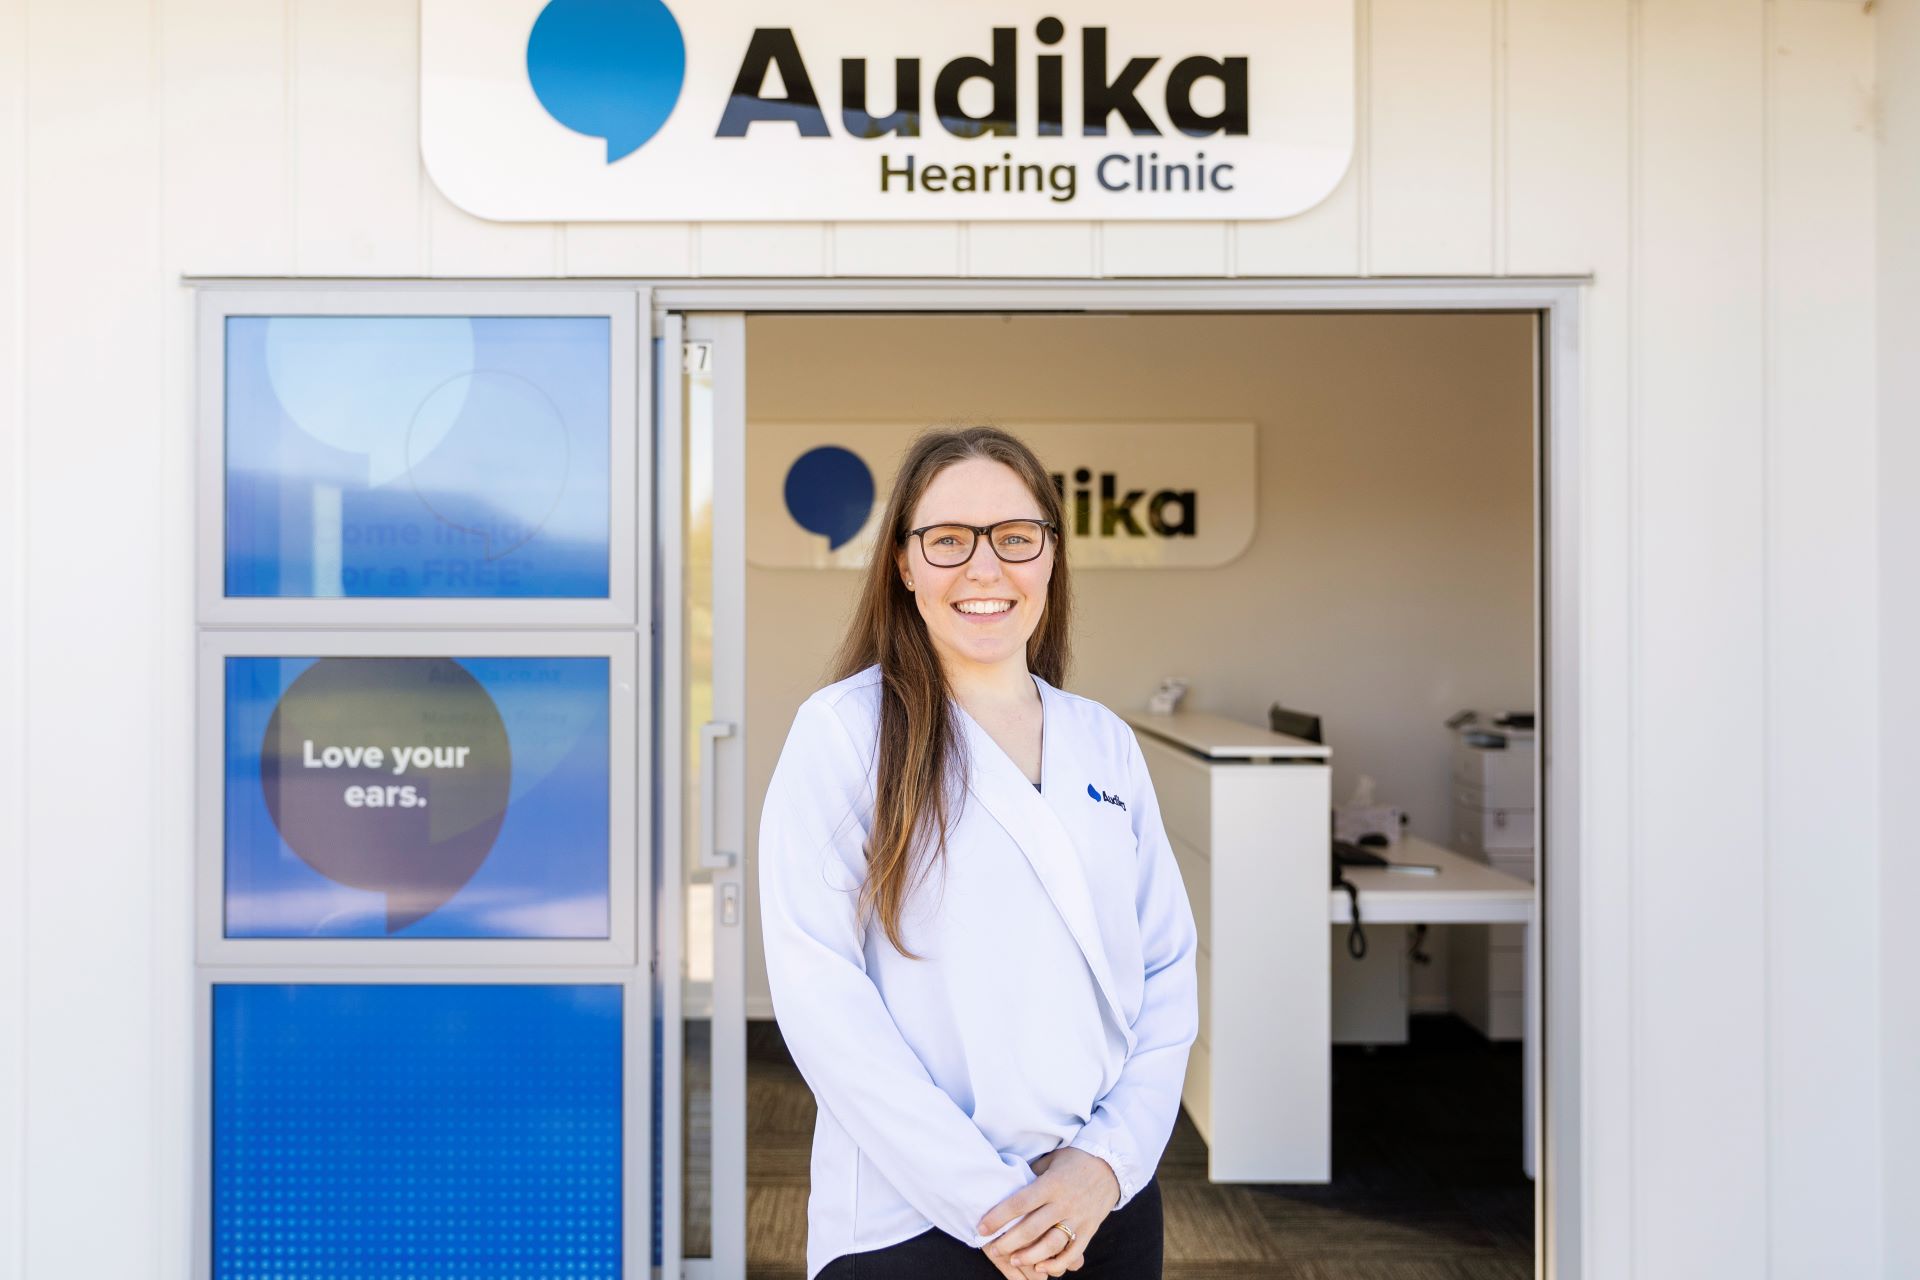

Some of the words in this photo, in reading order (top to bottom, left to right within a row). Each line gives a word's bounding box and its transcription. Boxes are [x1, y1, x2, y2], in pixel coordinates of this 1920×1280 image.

[715, 16, 1250, 139] Audika
[880, 152, 1077, 204] Hearing
[1095, 152, 1236, 193] Clinic
[1052, 467, 1197, 539] ika
[340, 520, 421, 545] ome
[303, 740, 384, 768] Love
[391, 746, 470, 775] your
[344, 785, 428, 808] ears.
